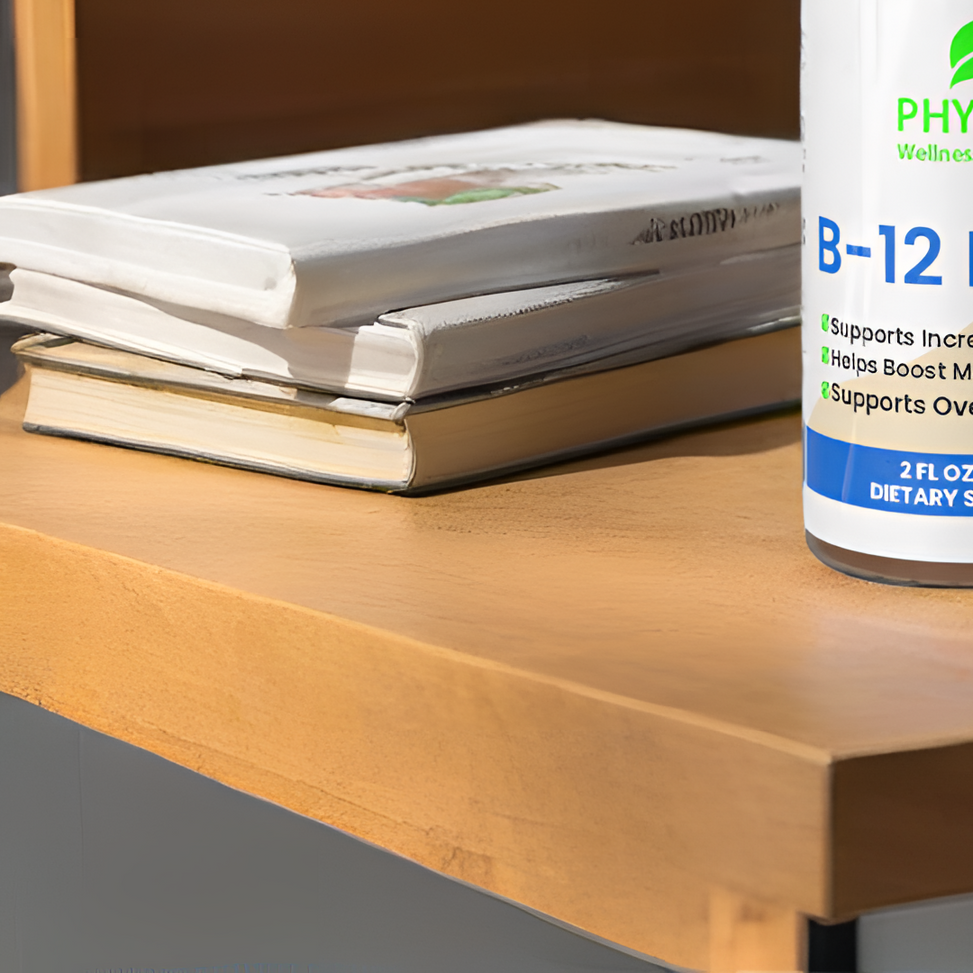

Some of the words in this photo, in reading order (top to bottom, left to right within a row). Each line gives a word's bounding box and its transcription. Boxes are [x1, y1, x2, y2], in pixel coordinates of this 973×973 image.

[818, 216, 943, 285] B-12
[830, 317, 915, 348] Supports
[831, 349, 878, 377] Helps
[883, 358, 947, 380] Boost
[831, 382, 926, 416] Supports
[900, 460, 912, 479] 2
[916, 462, 939, 481] FL
[870, 481, 958, 507] DIETARY
